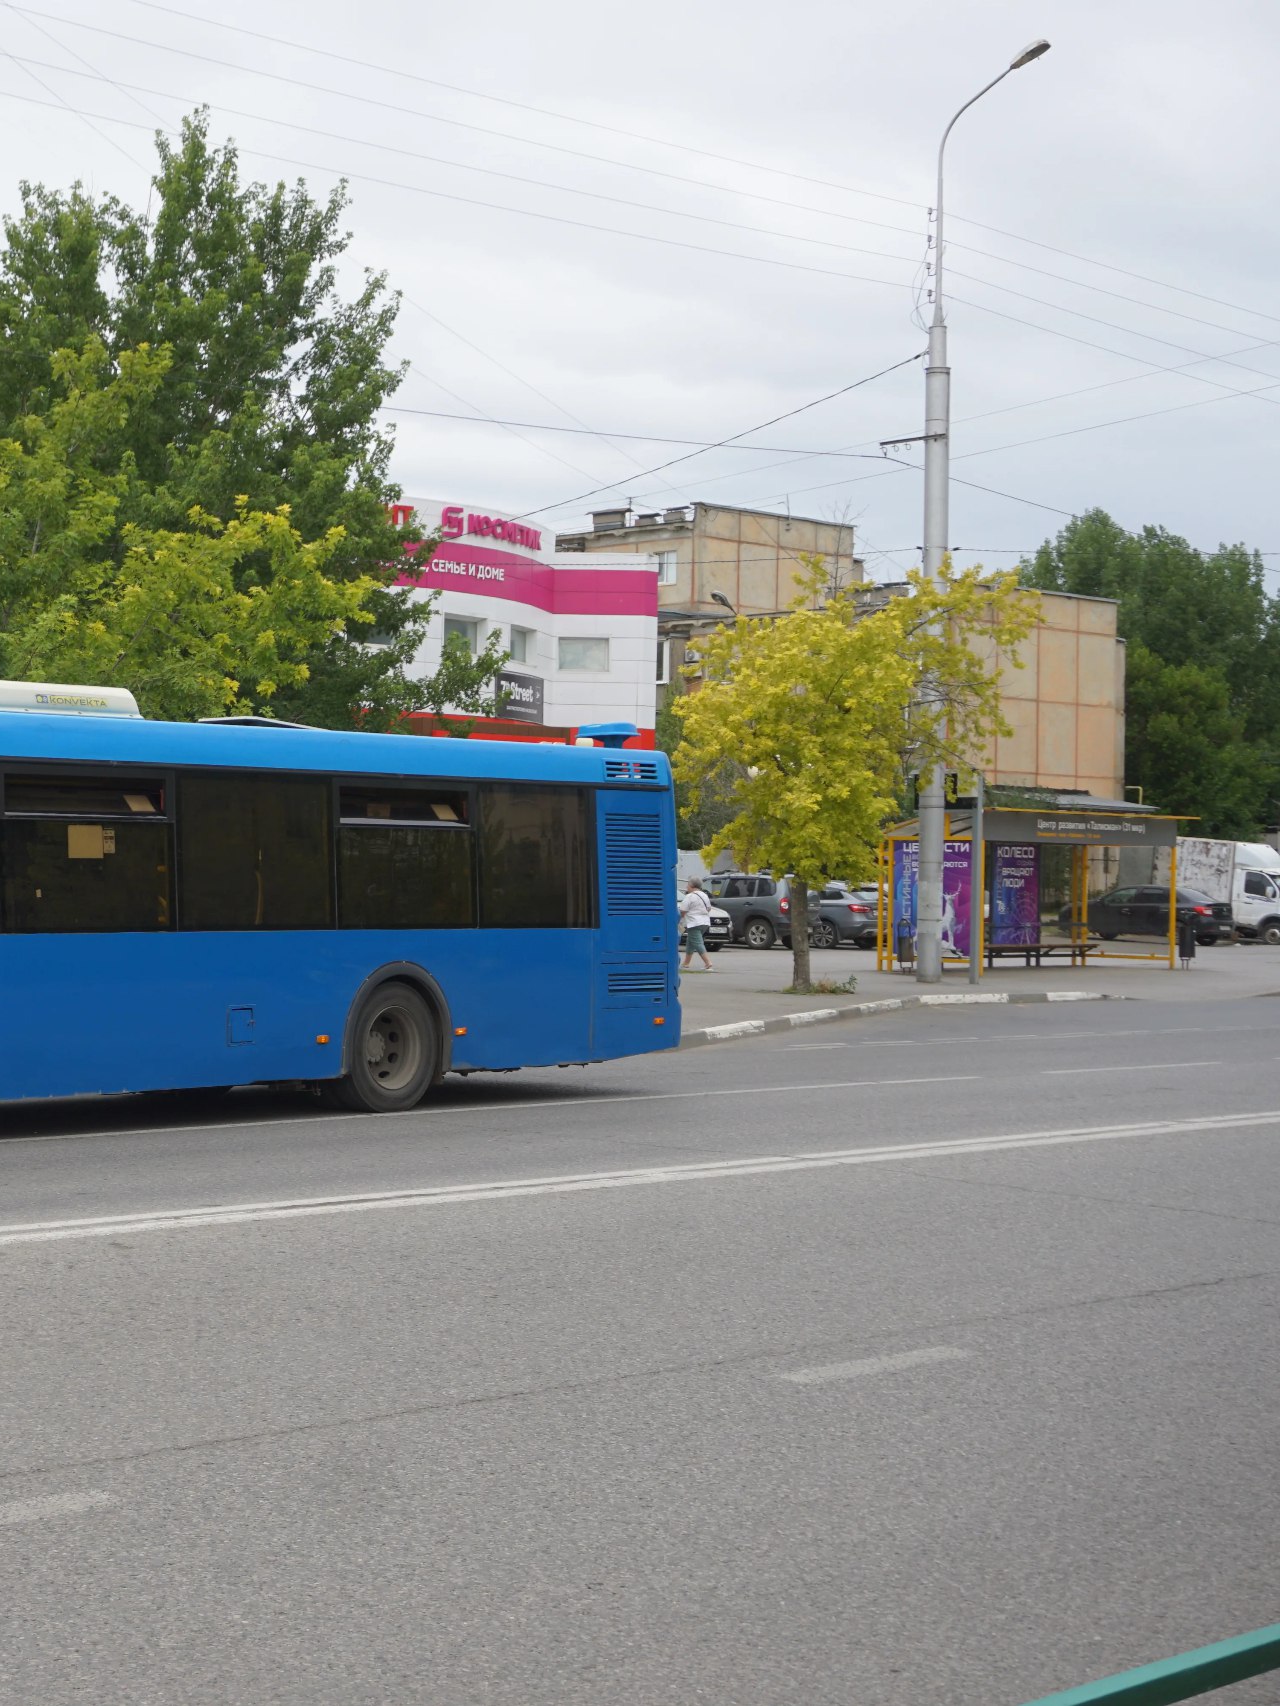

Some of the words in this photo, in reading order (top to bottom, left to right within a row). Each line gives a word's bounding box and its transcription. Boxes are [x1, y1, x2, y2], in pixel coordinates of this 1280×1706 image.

[467, 513, 542, 551] КОСМЕТИК
[431, 559, 466, 575] СЕМЬЕ
[468, 564, 476, 577] И
[477, 565, 505, 581] ДОМЕ
[50, 696, 108, 707] KONVEKTA
[1037, 818, 1057, 830] Центр
[903, 842, 970, 853] ЦЕСТИ
[997, 846, 1035, 858] КОЛЕСО
[1002, 867, 1034, 877] ВРАЩАЮТ
[1002, 878, 1025, 888] ЛЮДИ
